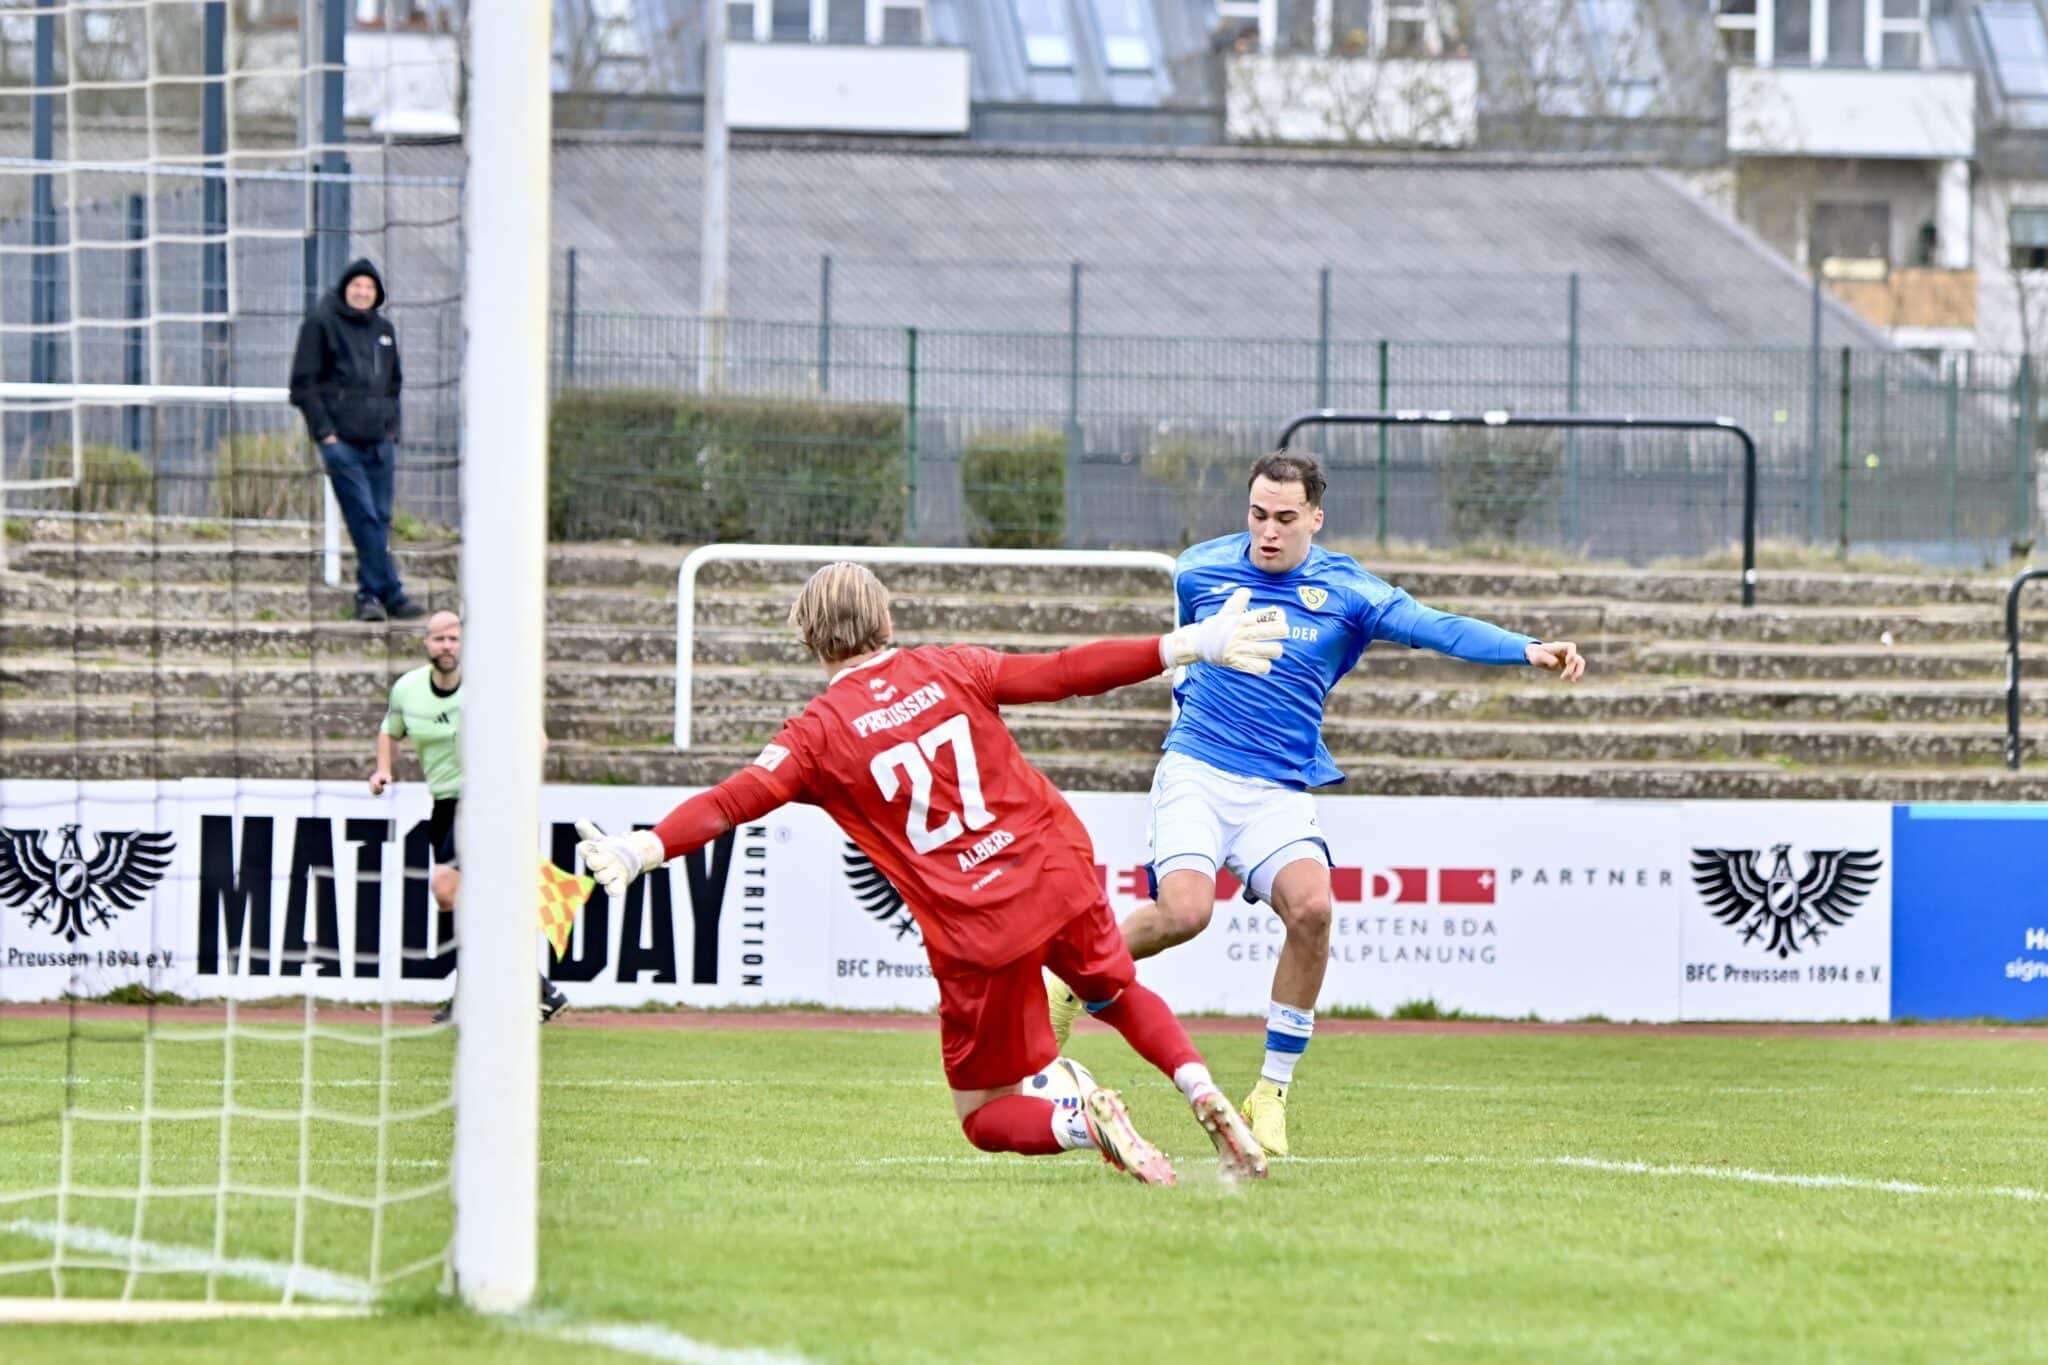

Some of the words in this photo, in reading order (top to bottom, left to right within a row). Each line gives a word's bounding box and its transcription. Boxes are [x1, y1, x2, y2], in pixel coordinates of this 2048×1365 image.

[852, 681, 946, 738] PREUSSEN
[869, 714, 996, 855] 27
[957, 830, 1015, 872] ALBERS
[1510, 868, 1673, 886] PARTNER
[742, 826, 767, 986] NUTRITION
[1443, 918, 1496, 937] BDA
[7, 947, 89, 967] Preussen
[837, 959, 869, 977] BFC
[876, 959, 933, 977] Preuss
[1685, 964, 1717, 983] BFC
[1724, 964, 1799, 983] Preussen
[1808, 965, 1848, 983] 1894
